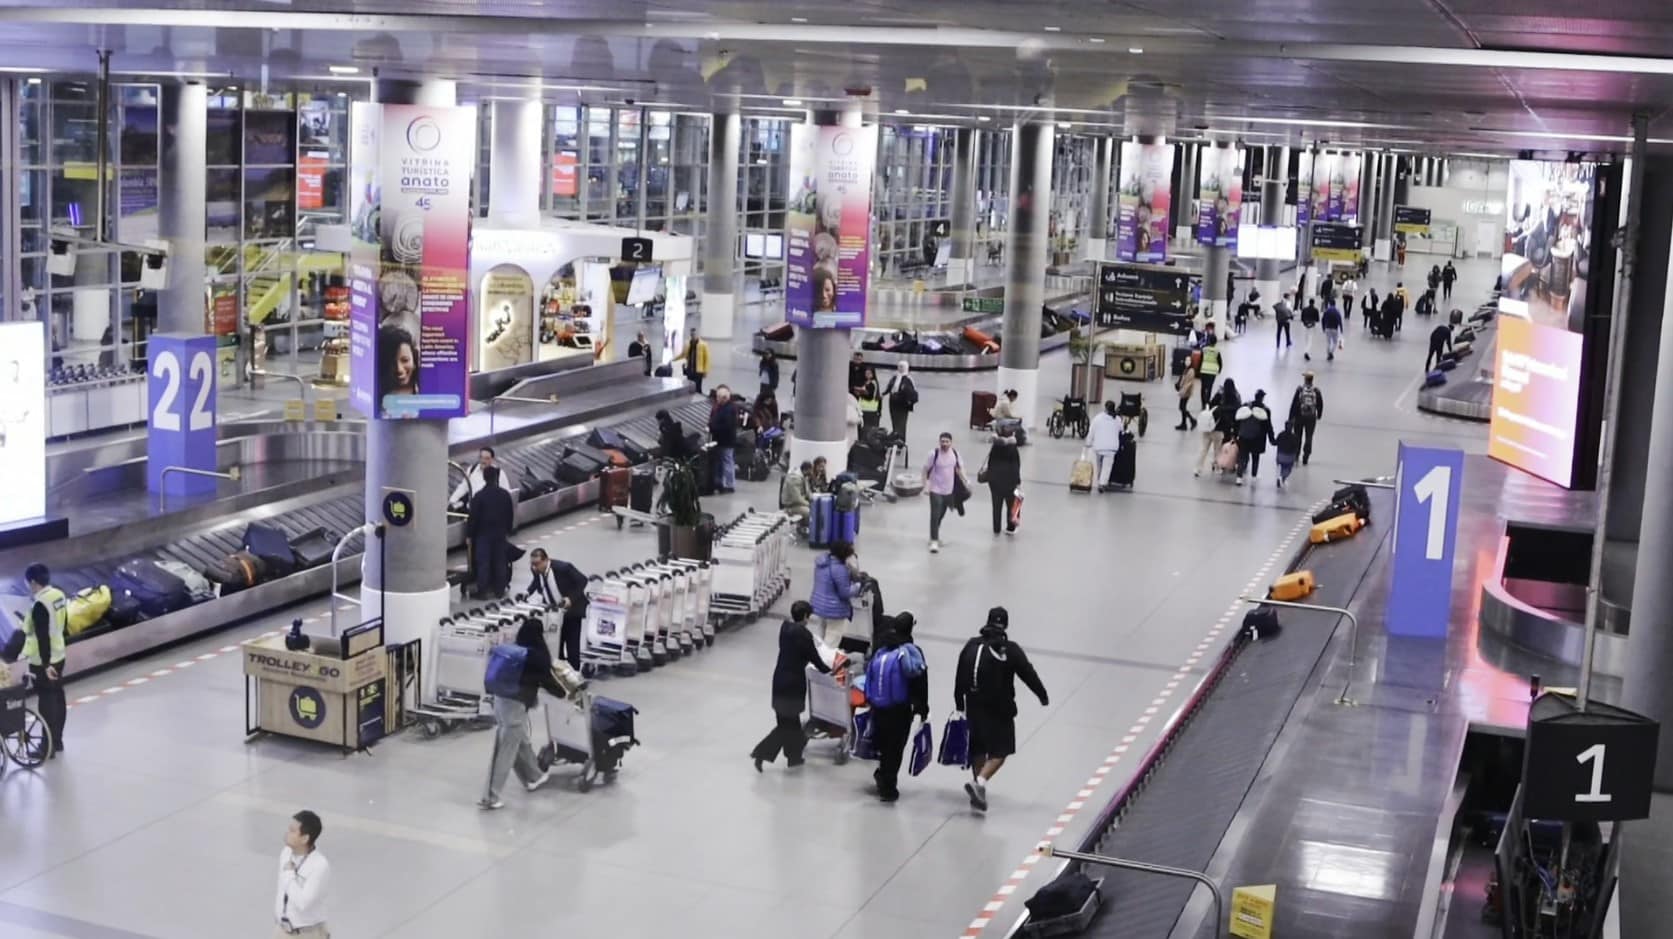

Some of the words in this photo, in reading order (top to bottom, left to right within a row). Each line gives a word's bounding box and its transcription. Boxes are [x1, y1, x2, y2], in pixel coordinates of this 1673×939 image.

[401, 158, 449, 167] VITRINA
[400, 177, 449, 187] anato
[415, 196, 431, 211] 45
[936, 223, 944, 235] 4
[633, 243, 643, 258] 2
[153, 350, 181, 432] 2
[189, 351, 213, 432] 2
[1413, 465, 1452, 560] 1
[248, 652, 311, 672] TROLLEY
[318, 665, 340, 678] GO
[1575, 743, 1612, 802] 1
